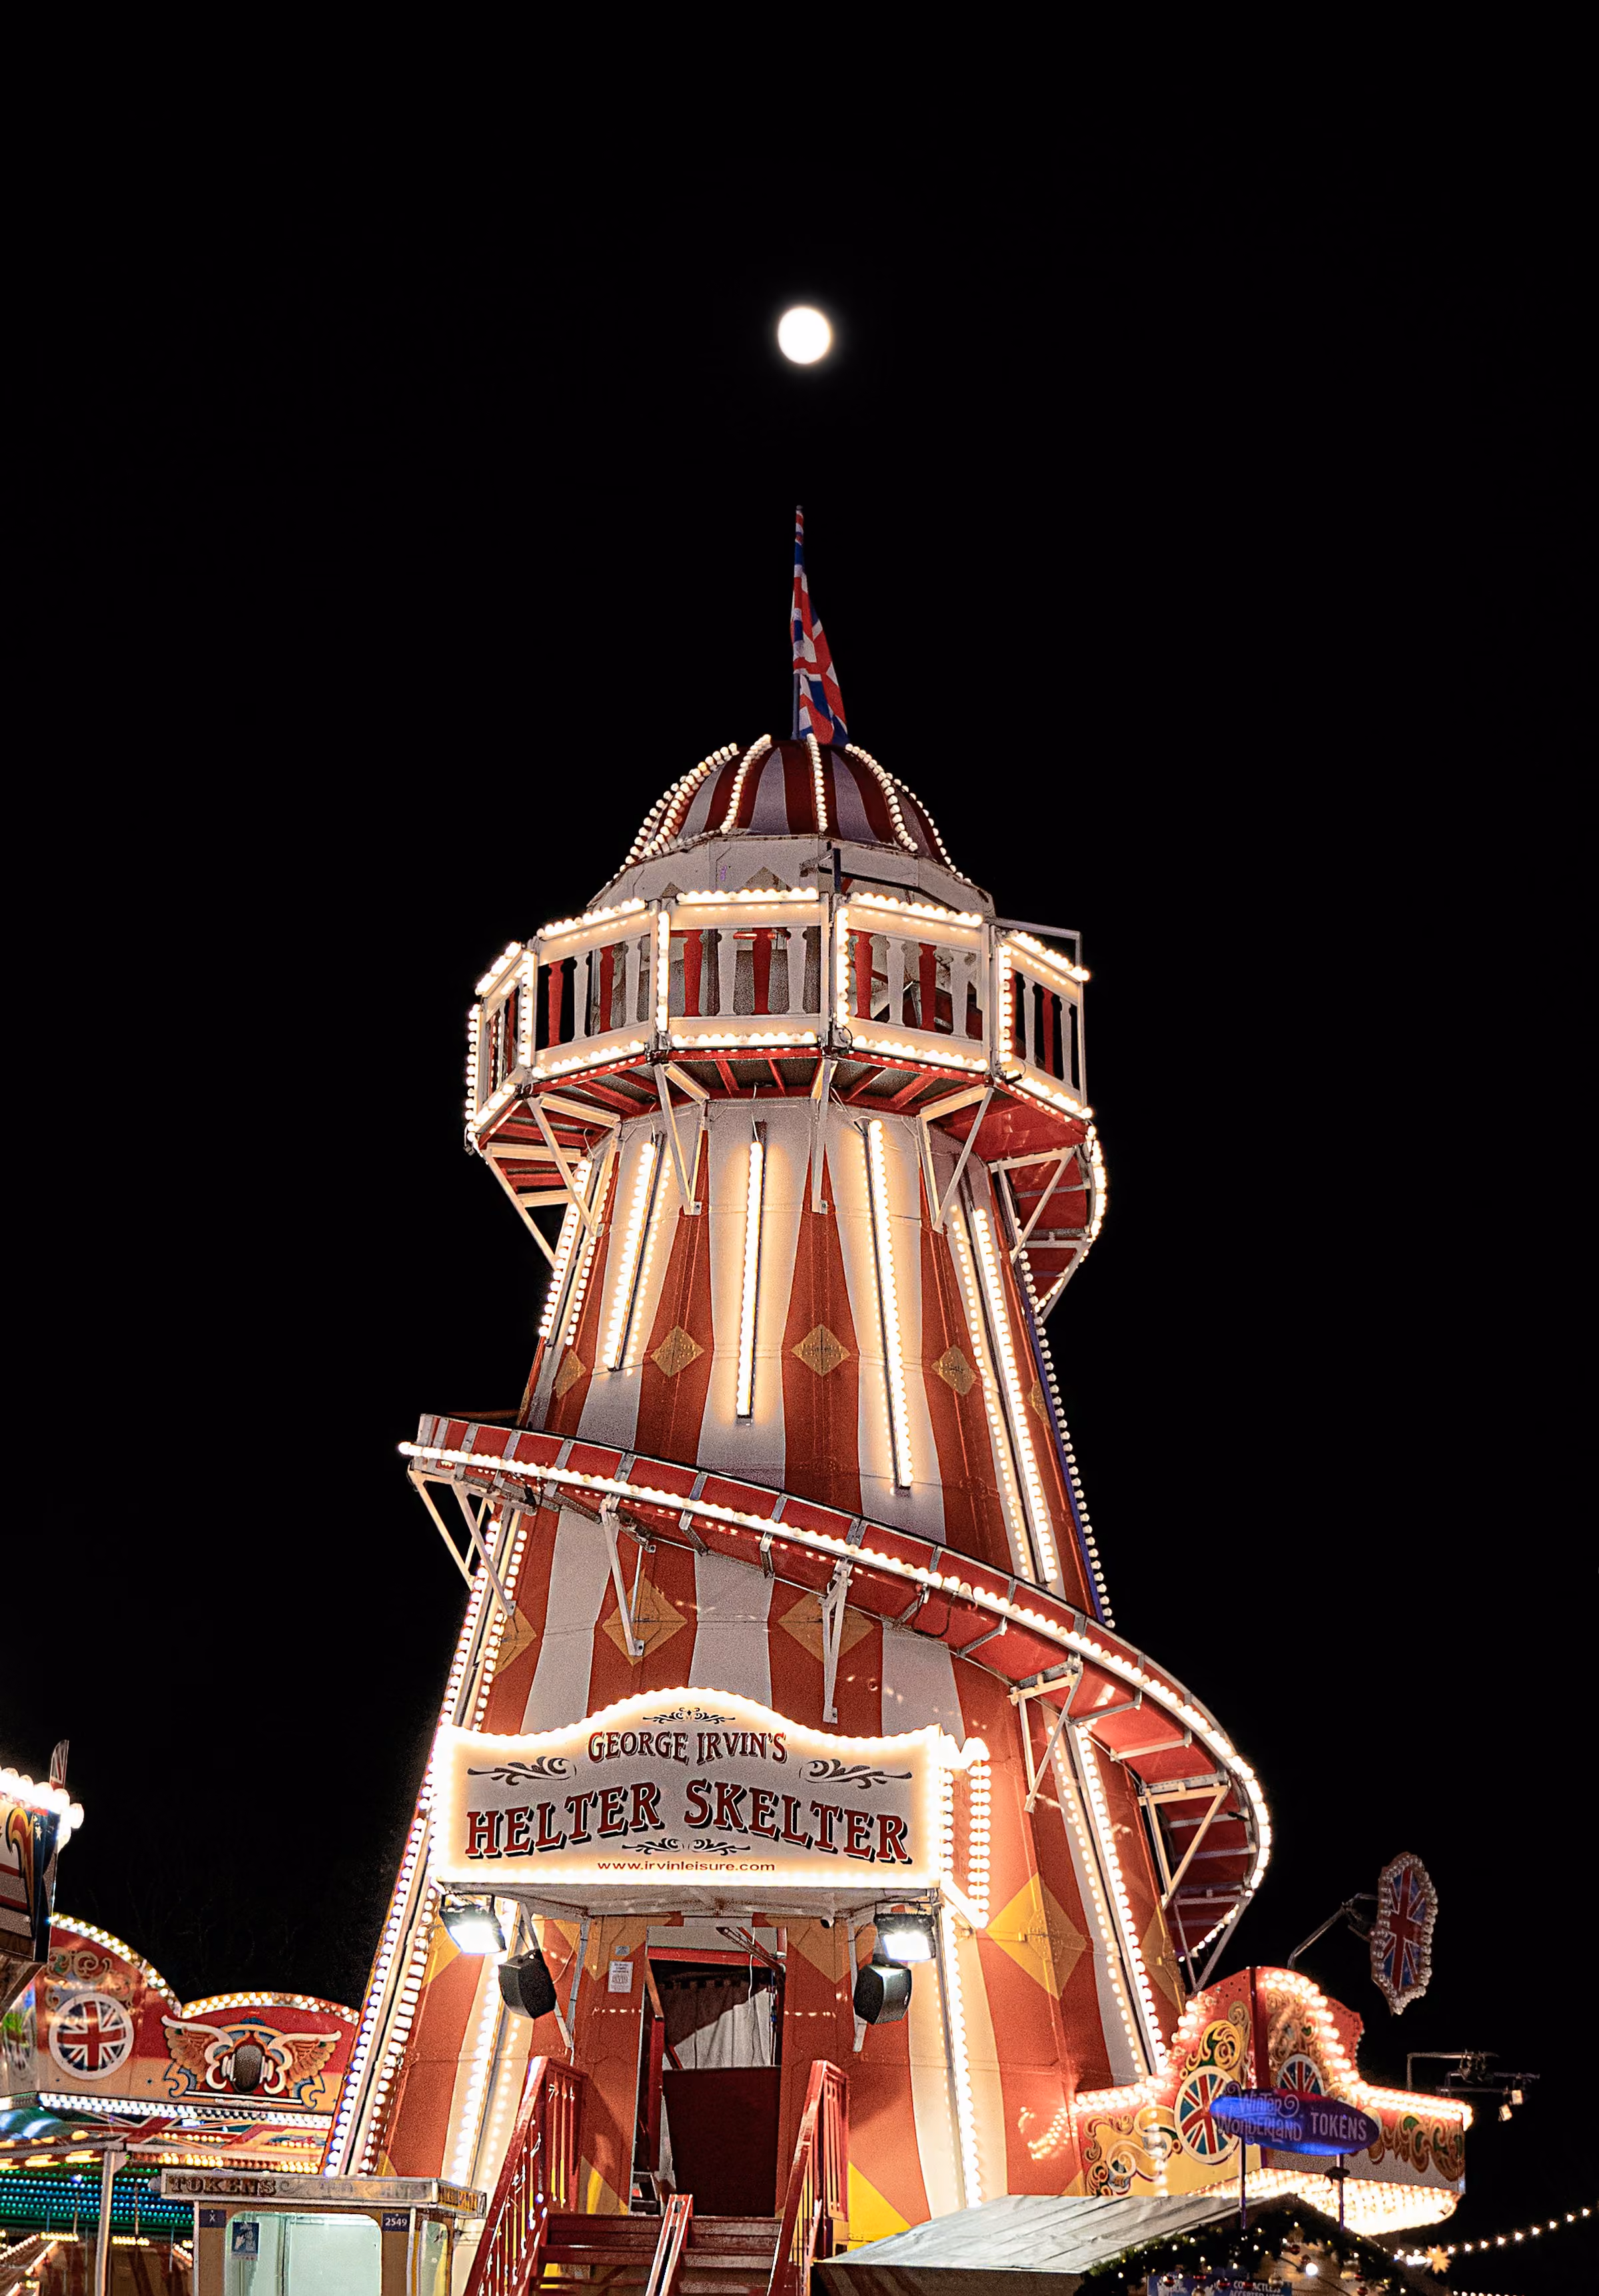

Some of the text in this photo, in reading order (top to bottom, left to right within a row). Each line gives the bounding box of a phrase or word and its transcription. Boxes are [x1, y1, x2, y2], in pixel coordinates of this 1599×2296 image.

[588, 1731, 788, 1765] GEORGE IRVIN'S
[464, 1778, 913, 1865] HELTER SKELTER
[598, 1861, 775, 1871] www.irvinleisure.com
[1311, 2111, 1366, 2141] TOKENS
[169, 2175, 276, 2196] TOKENS
[384, 2217, 408, 2226] 2549
[1233, 2280, 1281, 2293] COACTLESS
